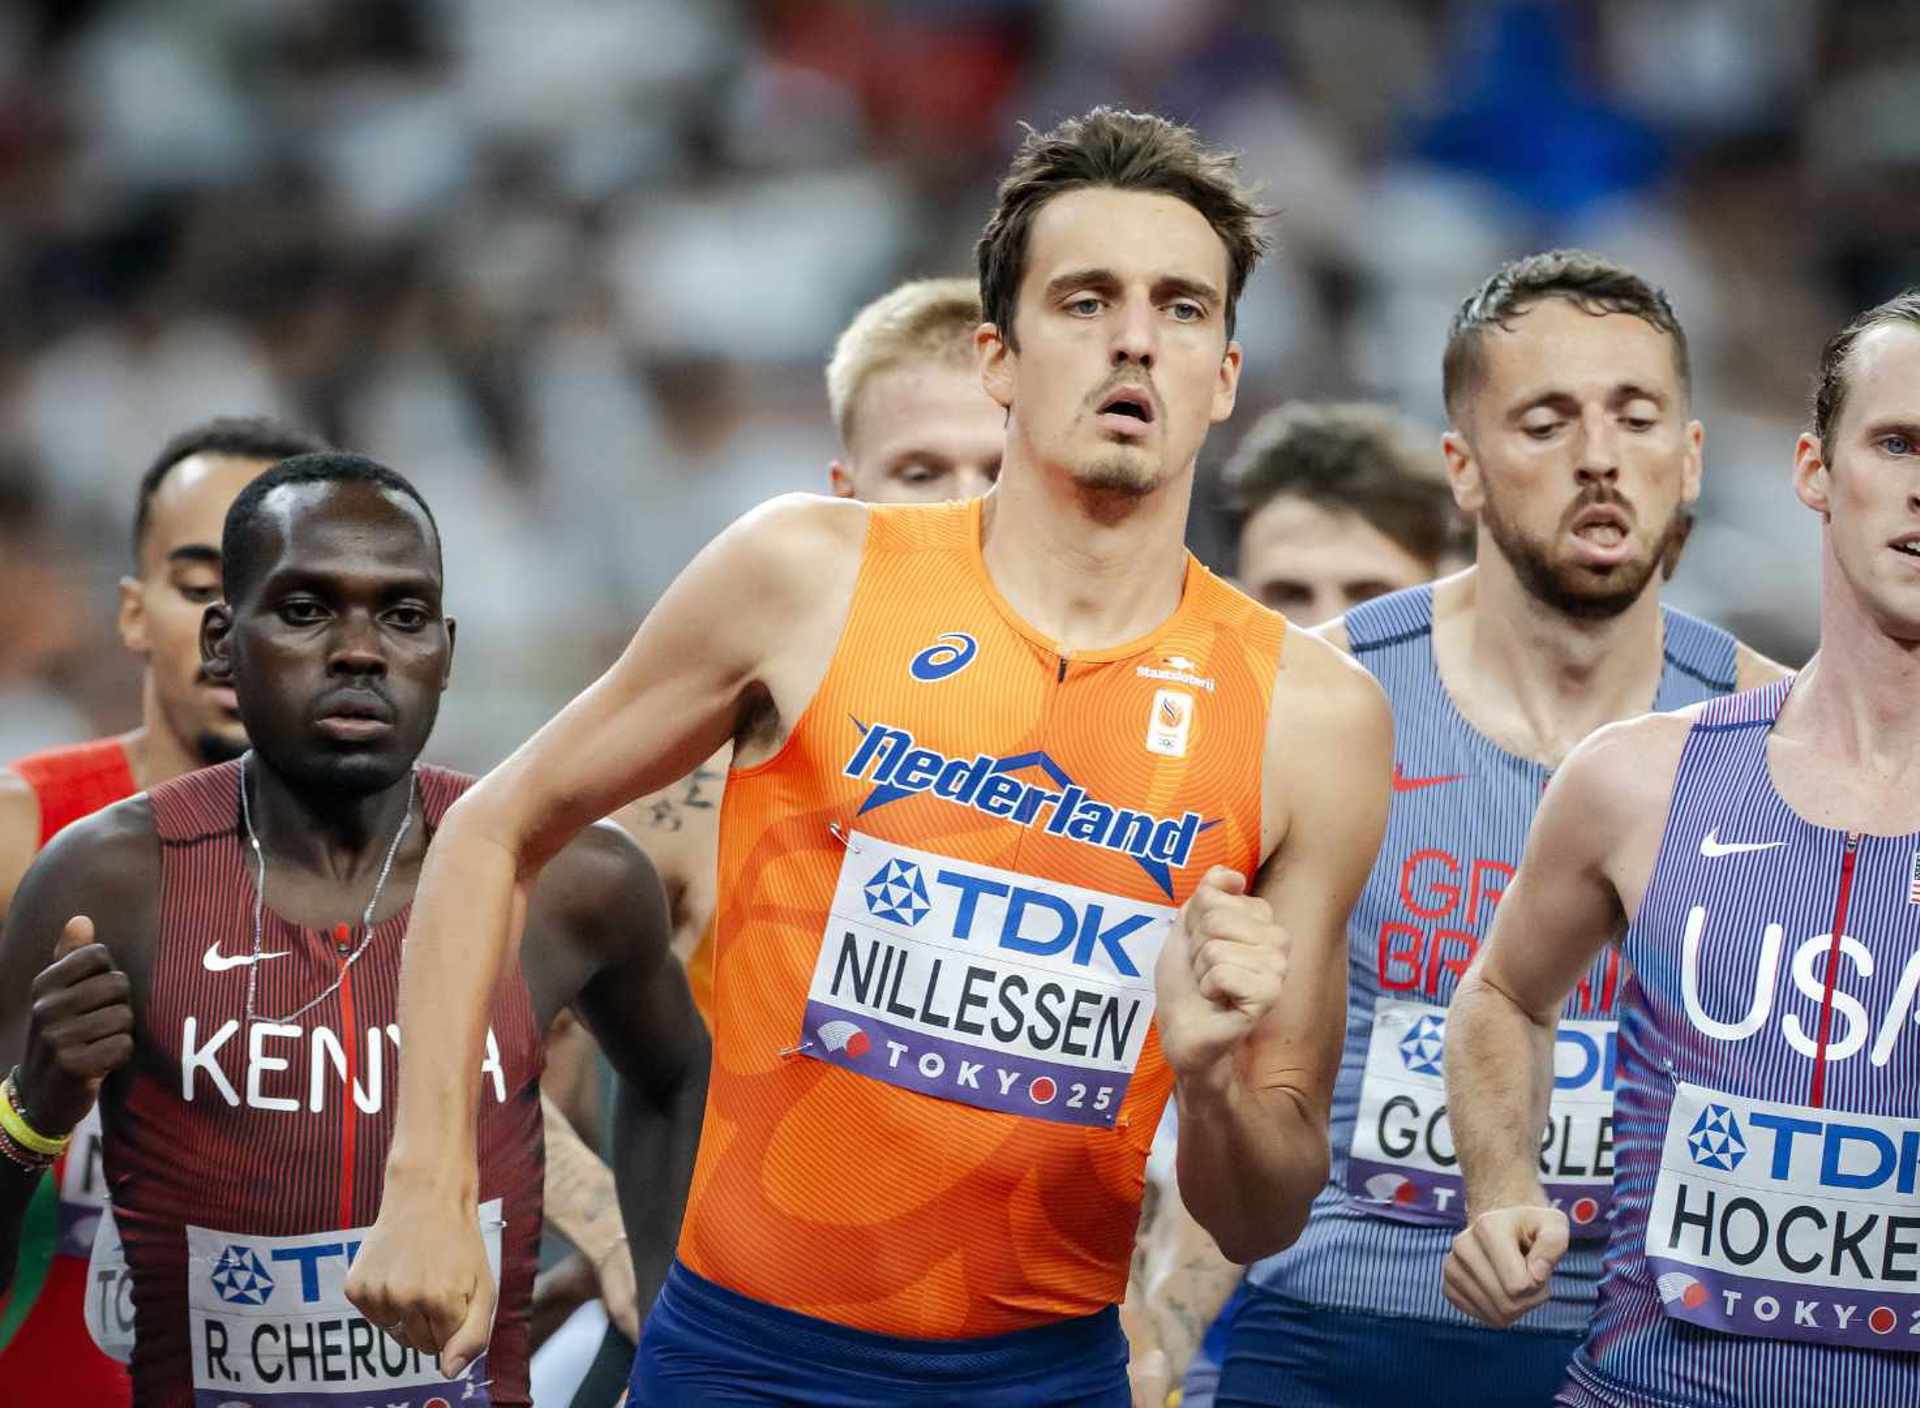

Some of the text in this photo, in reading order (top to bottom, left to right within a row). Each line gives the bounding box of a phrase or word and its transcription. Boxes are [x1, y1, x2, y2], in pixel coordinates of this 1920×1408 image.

[843, 723, 1202, 868] Nederland
[936, 869, 1157, 978] TDK
[830, 931, 1141, 1062] NILLESSEN
[1066, 1083, 1113, 1110] 25
[204, 1319, 241, 1383] R.
